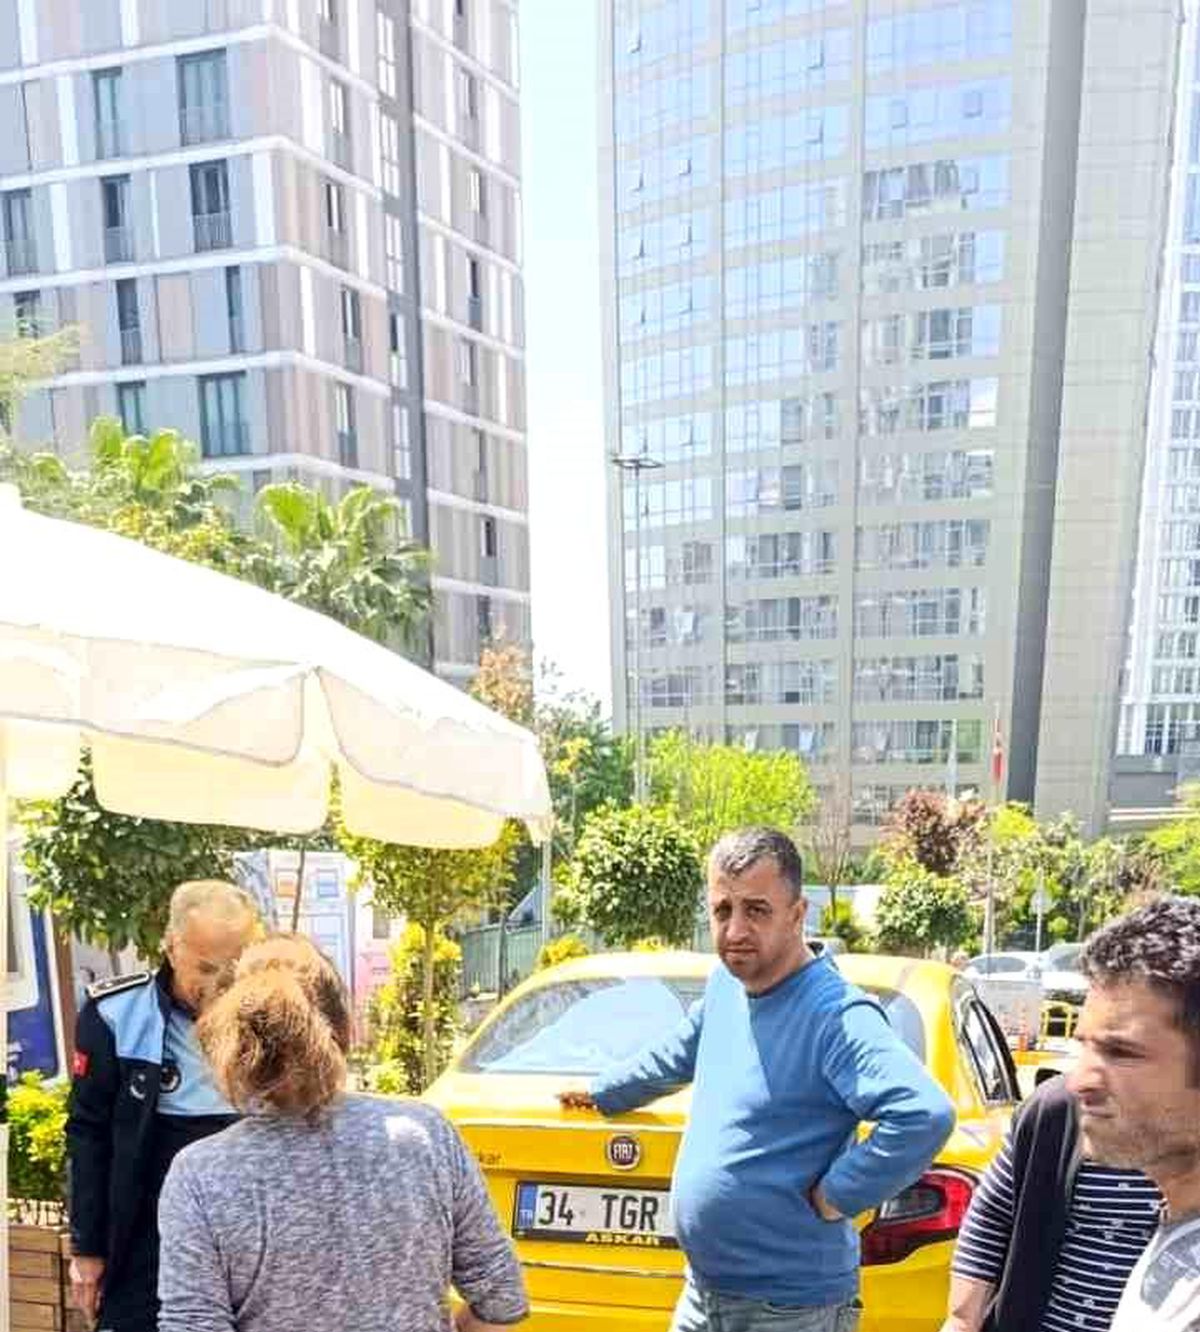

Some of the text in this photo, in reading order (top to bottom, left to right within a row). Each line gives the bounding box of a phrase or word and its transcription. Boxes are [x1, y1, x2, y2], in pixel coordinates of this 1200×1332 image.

[612, 1143, 633, 1160] FIAT
[538, 1191, 574, 1226] 34
[600, 1194, 659, 1231] TGR
